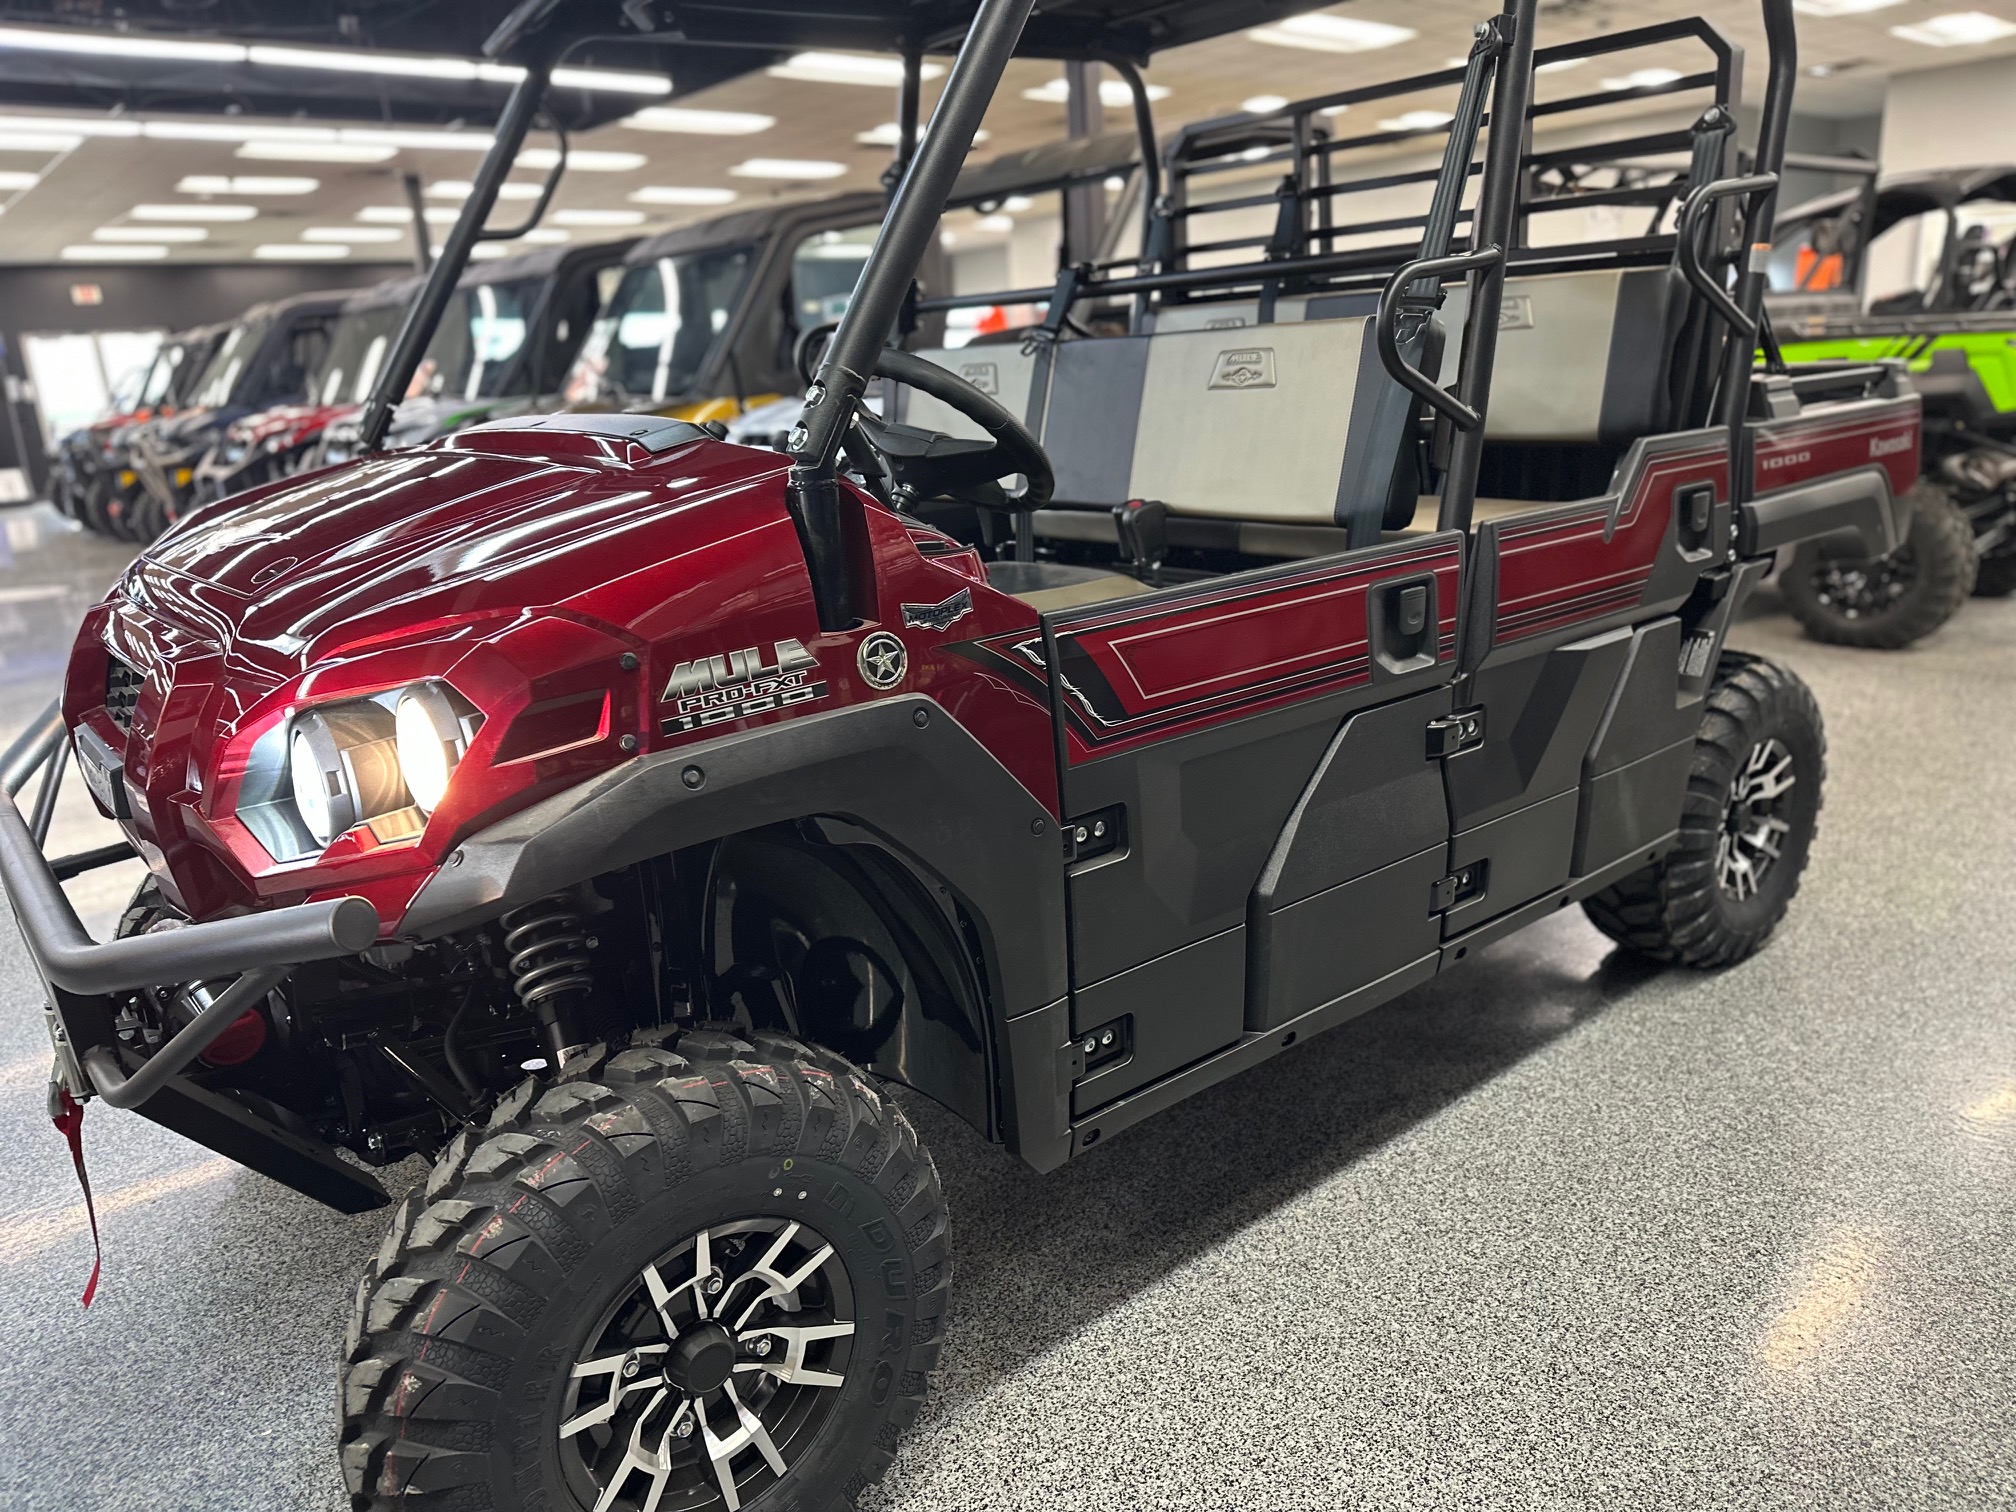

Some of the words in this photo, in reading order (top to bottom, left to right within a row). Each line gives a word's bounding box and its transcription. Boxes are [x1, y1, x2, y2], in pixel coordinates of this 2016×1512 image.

[1762, 451, 1811, 470] 1000
[907, 601, 968, 622] MOTOPLEX
[660, 637, 820, 702] MULE
[677, 670, 807, 714] PRO-FXT
[679, 686, 815, 730] 1000
